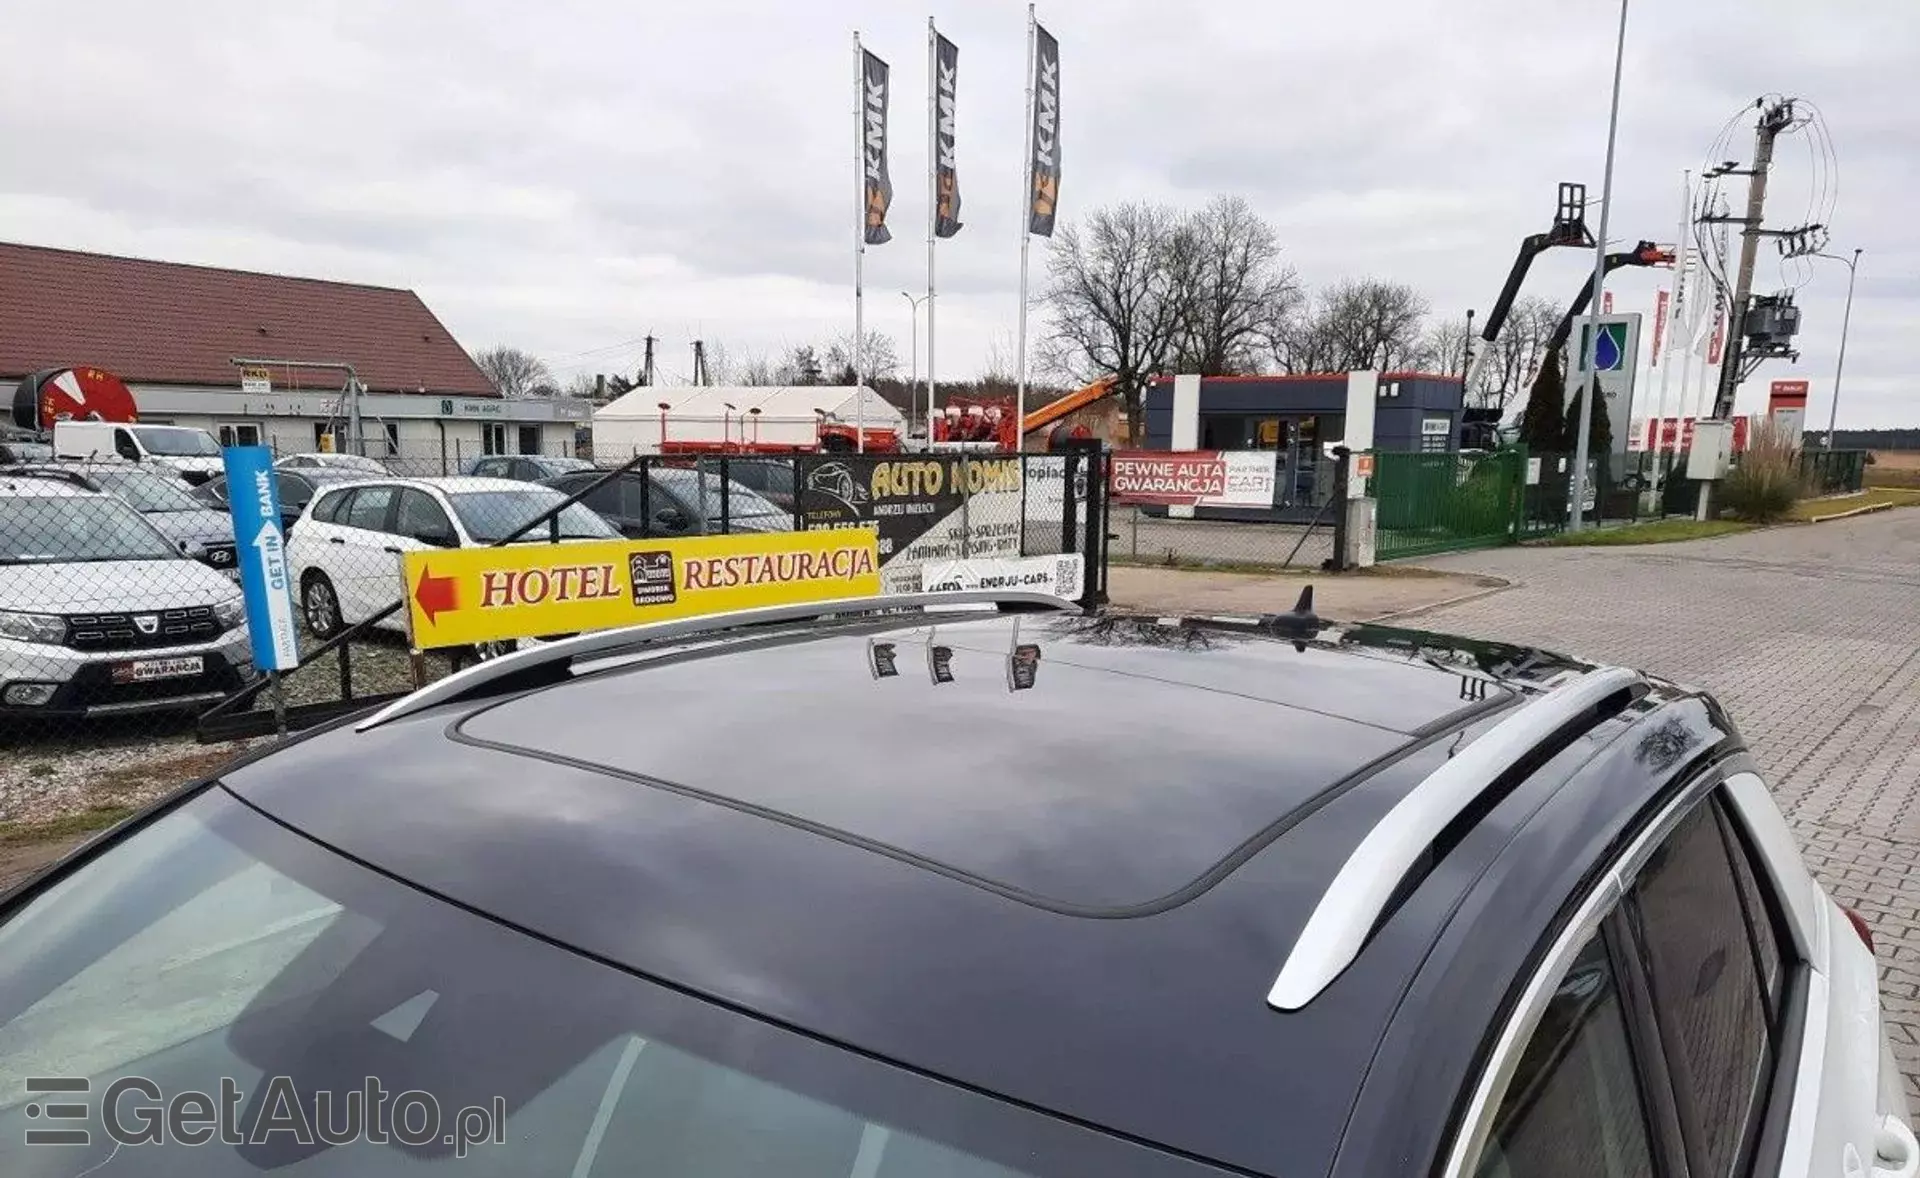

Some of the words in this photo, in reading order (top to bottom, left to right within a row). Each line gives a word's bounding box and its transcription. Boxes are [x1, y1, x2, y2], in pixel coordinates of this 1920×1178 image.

[866, 77, 883, 181] KMK
[939, 60, 956, 168] KMK
[1037, 54, 1057, 166] KMK
[871, 461, 943, 501] AUTO
[1114, 462, 1174, 475] PEWNE
[1177, 463, 1224, 477] AUTA
[1114, 477, 1222, 493] GWARANCJA
[255, 470, 274, 517] BANK
[265, 535, 282, 554] IN
[265, 558, 284, 590] GET
[481, 564, 621, 608] HOTEL
[683, 547, 874, 591] RESTAURACJA
[135, 662, 201, 676] GWARANCJA
